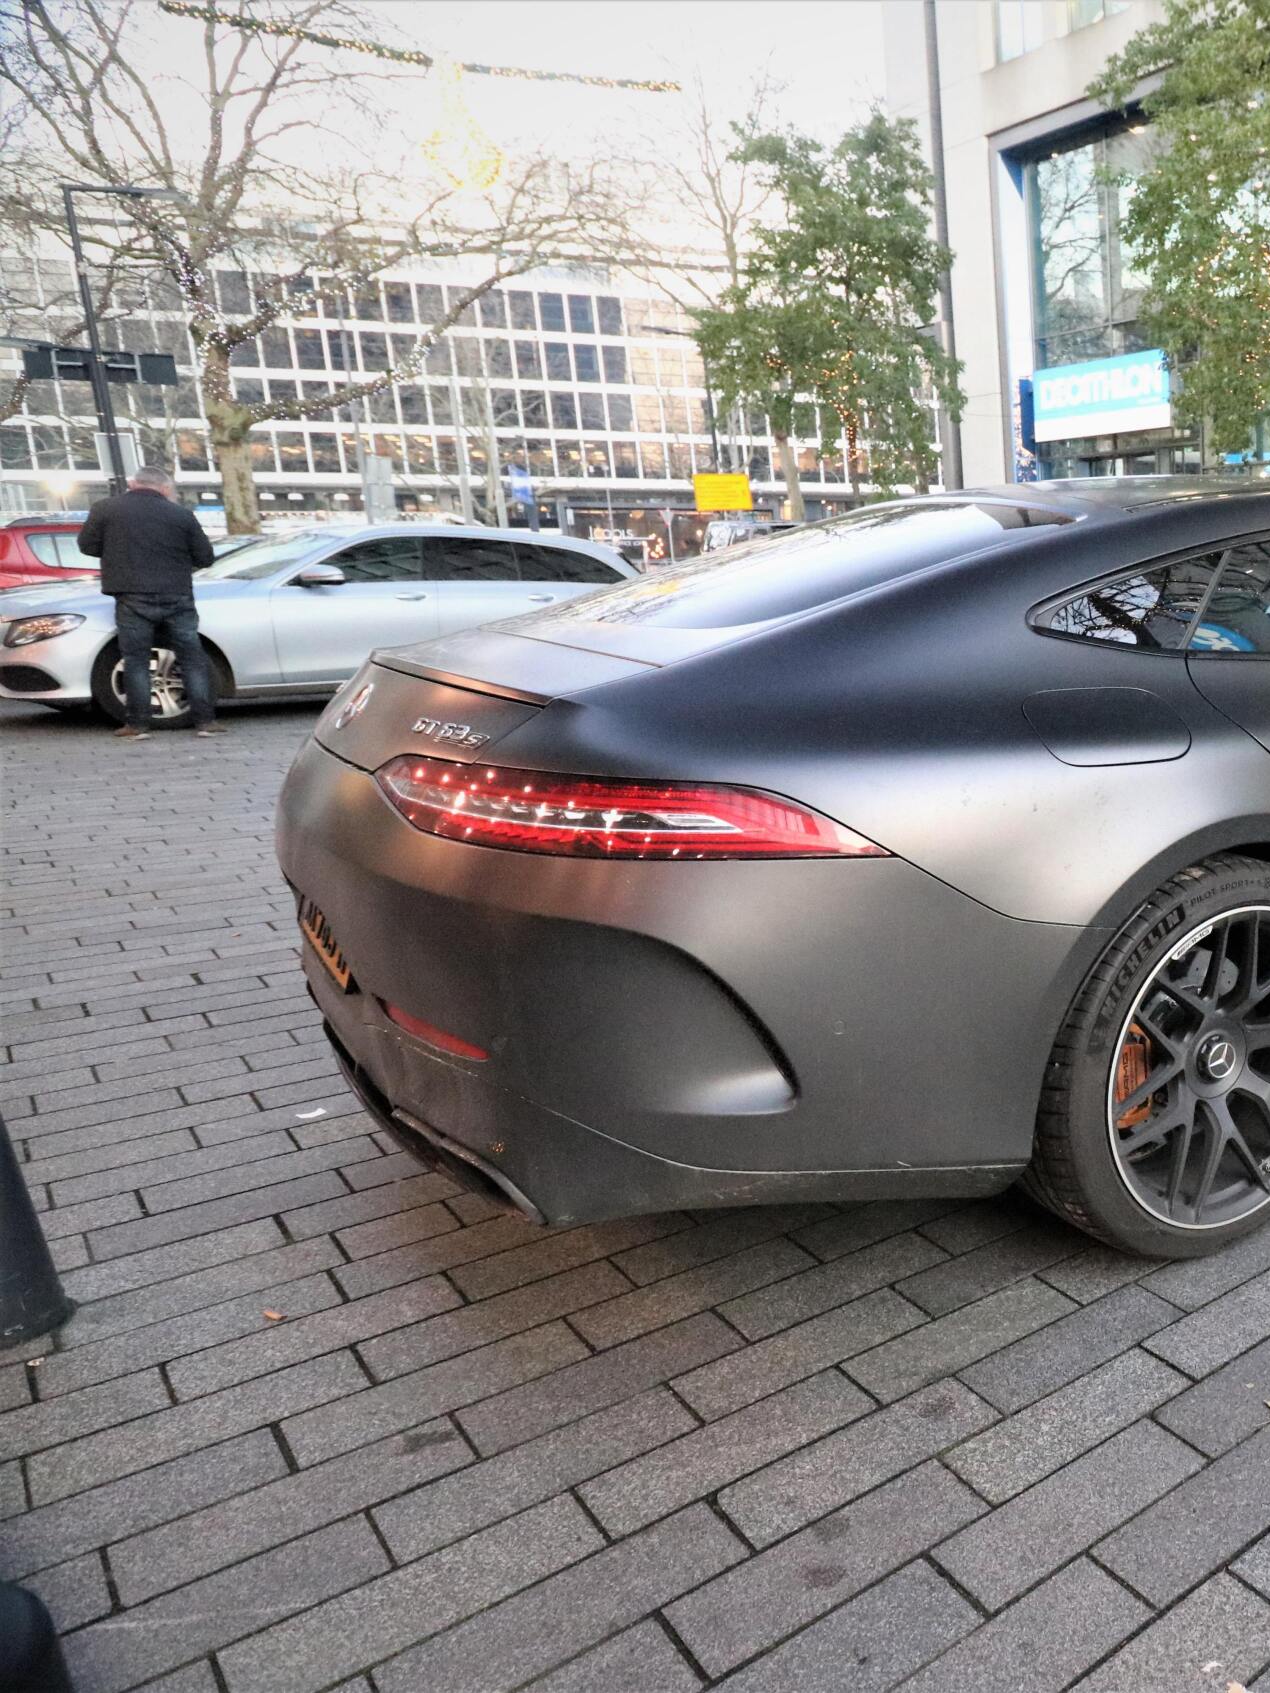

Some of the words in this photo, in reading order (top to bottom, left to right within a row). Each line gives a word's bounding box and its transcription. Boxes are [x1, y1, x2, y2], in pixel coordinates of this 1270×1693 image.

[1040, 361, 1163, 410] DECATHLON
[411, 717, 441, 736] GT
[1190, 887, 1217, 907] PILOT
[1100, 905, 1184, 1018] MICHELIN
